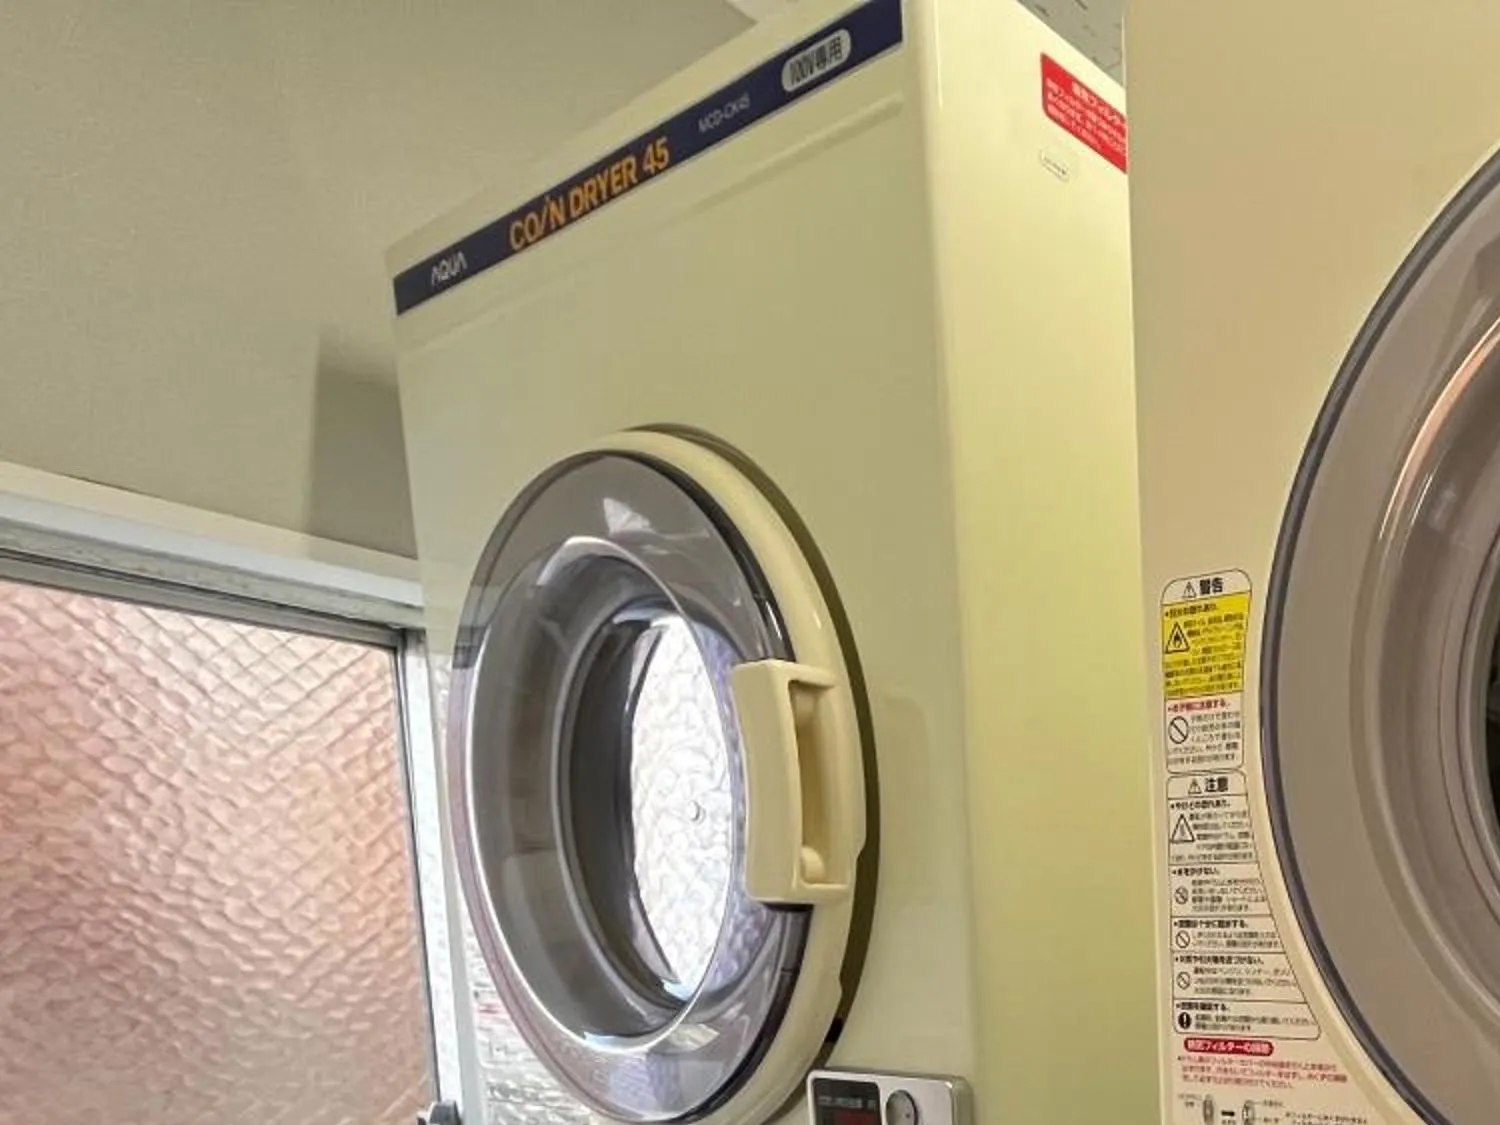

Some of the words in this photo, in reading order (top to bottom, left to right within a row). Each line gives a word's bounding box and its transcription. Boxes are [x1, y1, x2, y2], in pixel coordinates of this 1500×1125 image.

[570, 155, 637, 218] DRYER
[643, 136, 670, 175] 45
[431, 252, 468, 285] AQUA
[1200, 577, 1223, 595] 警告
[1205, 777, 1228, 792] 注意
